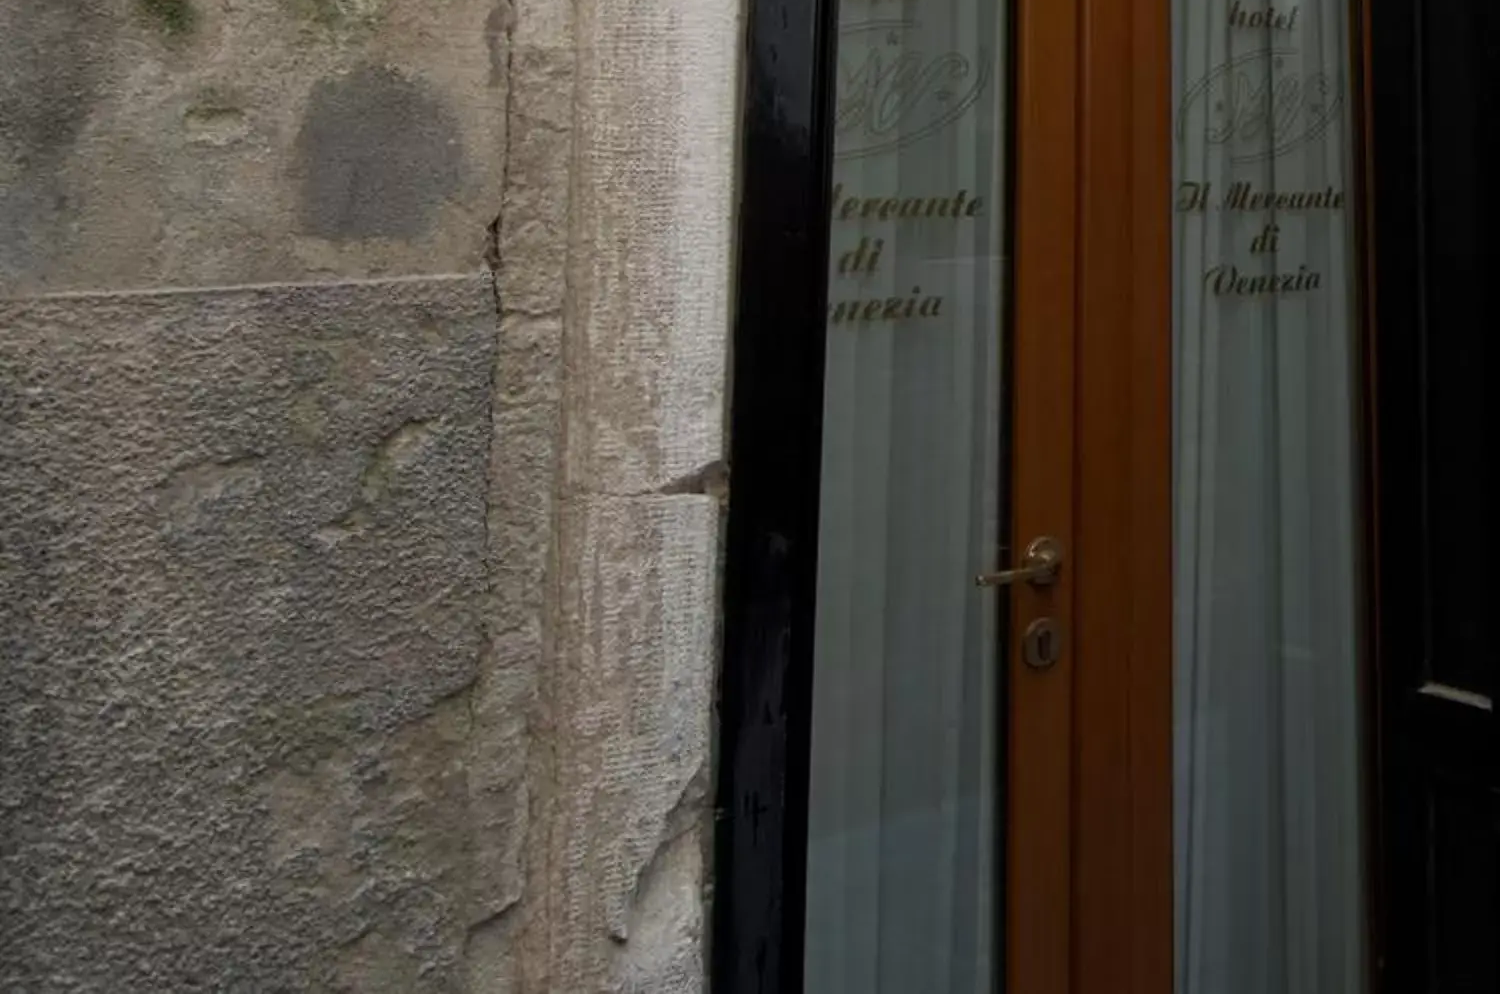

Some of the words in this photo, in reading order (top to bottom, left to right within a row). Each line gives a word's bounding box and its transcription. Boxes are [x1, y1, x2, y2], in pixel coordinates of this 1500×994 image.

[1228, 0, 1299, 31] hotel
[833, 183, 984, 219] ercante
[1177, 181, 1211, 212] Il
[1217, 181, 1345, 211] Mercante
[1249, 223, 1281, 254] di
[838, 236, 884, 276] di
[1204, 264, 1321, 297] Venezia
[830, 286, 943, 325] nezia
